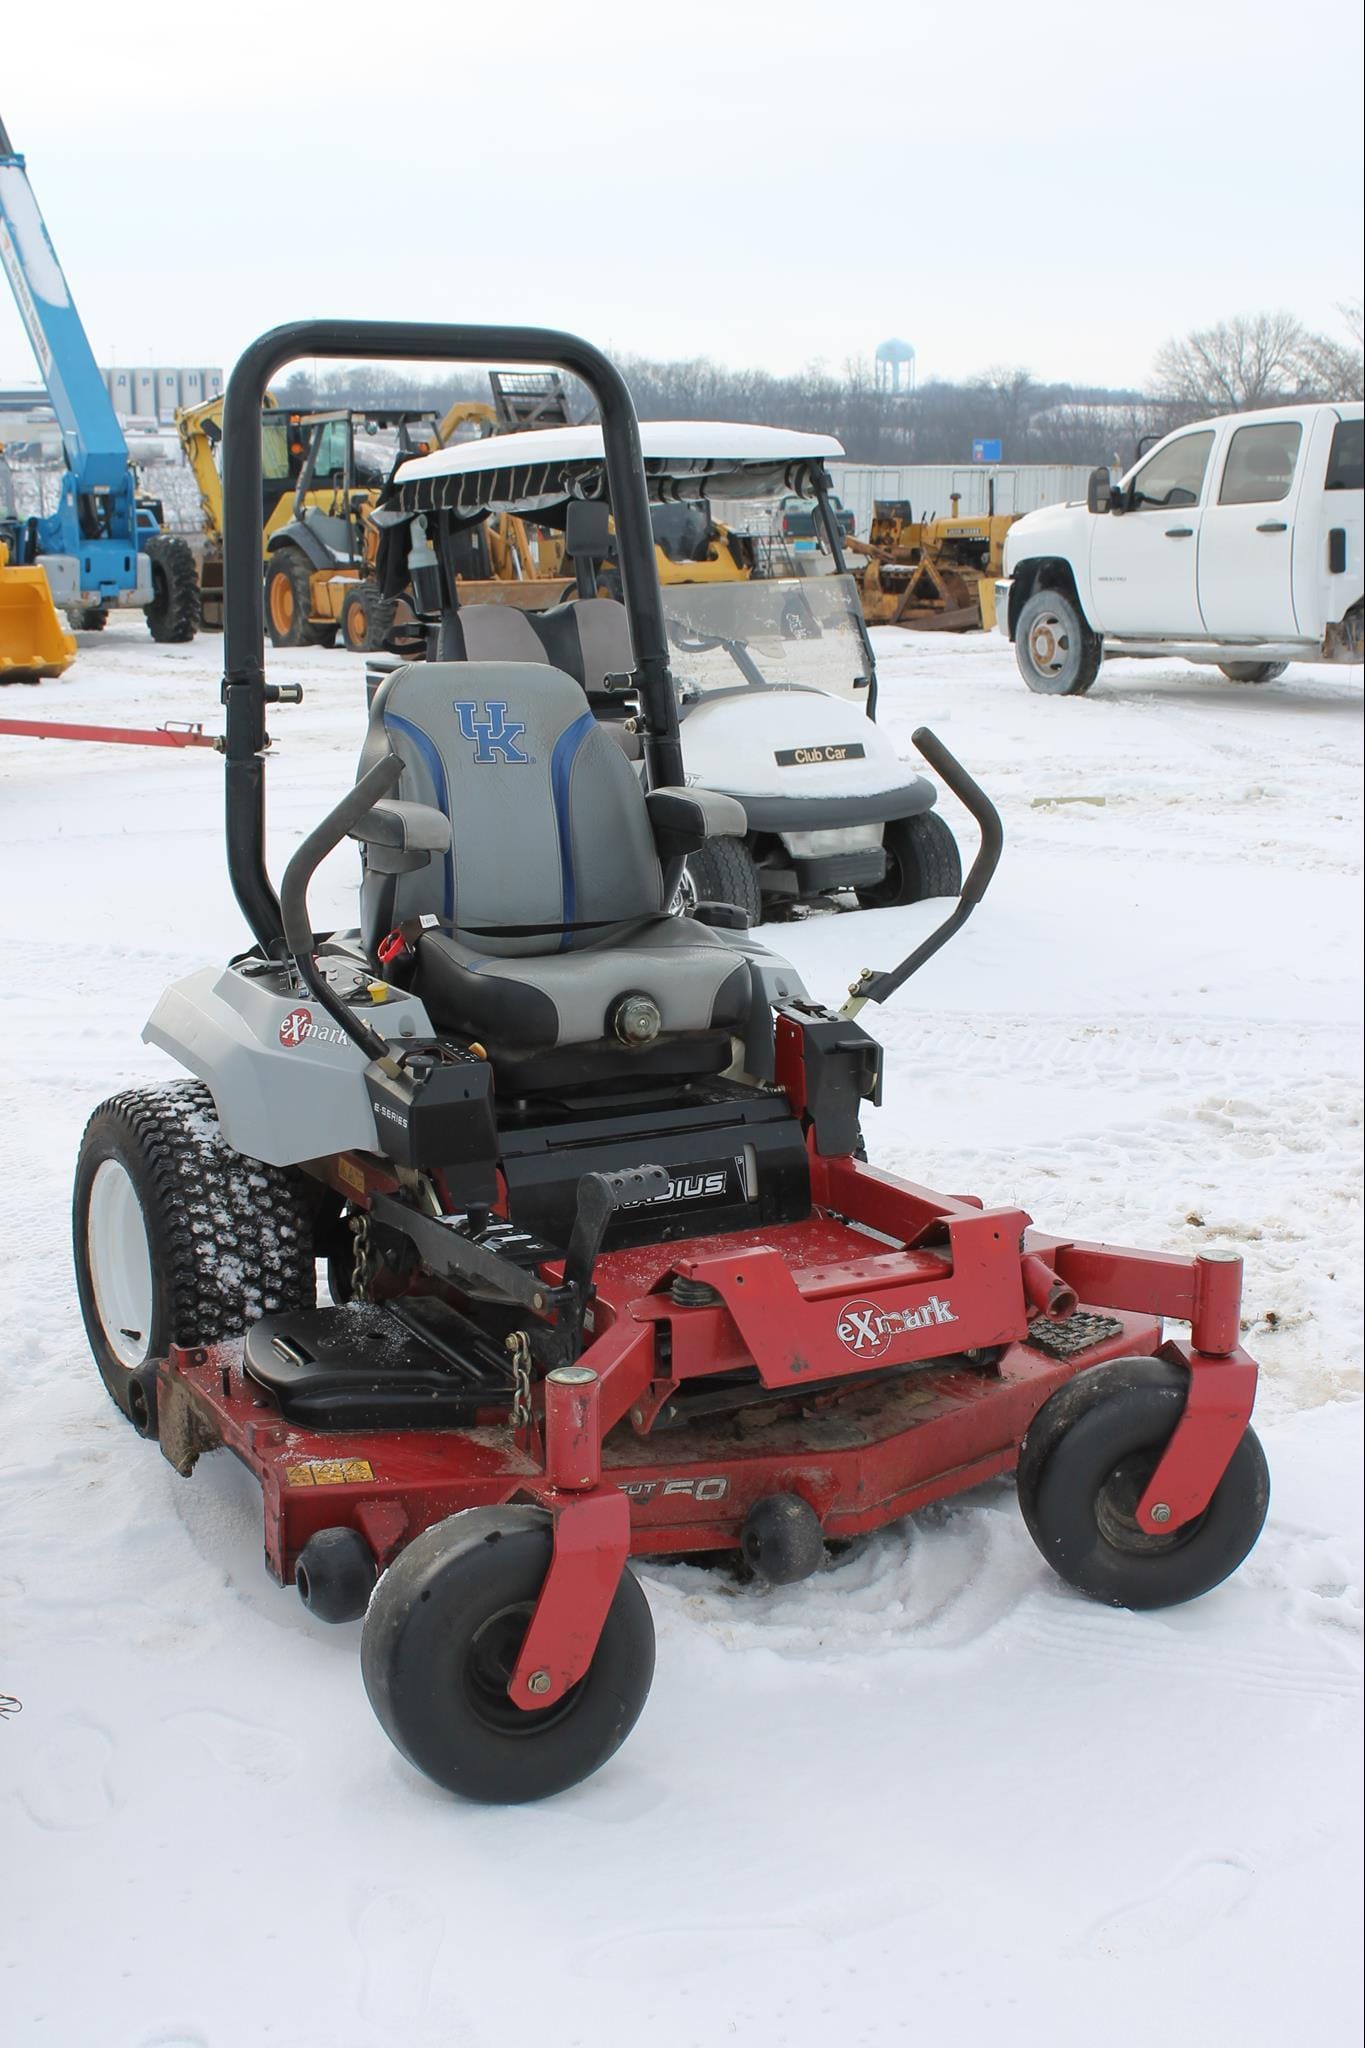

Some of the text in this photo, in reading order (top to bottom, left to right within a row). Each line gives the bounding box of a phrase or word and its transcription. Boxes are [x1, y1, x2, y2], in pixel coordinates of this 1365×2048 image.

[453, 702, 528, 763] UK
[795, 746, 847, 763] Club Car
[373, 1102, 408, 1129] E-SERIES
